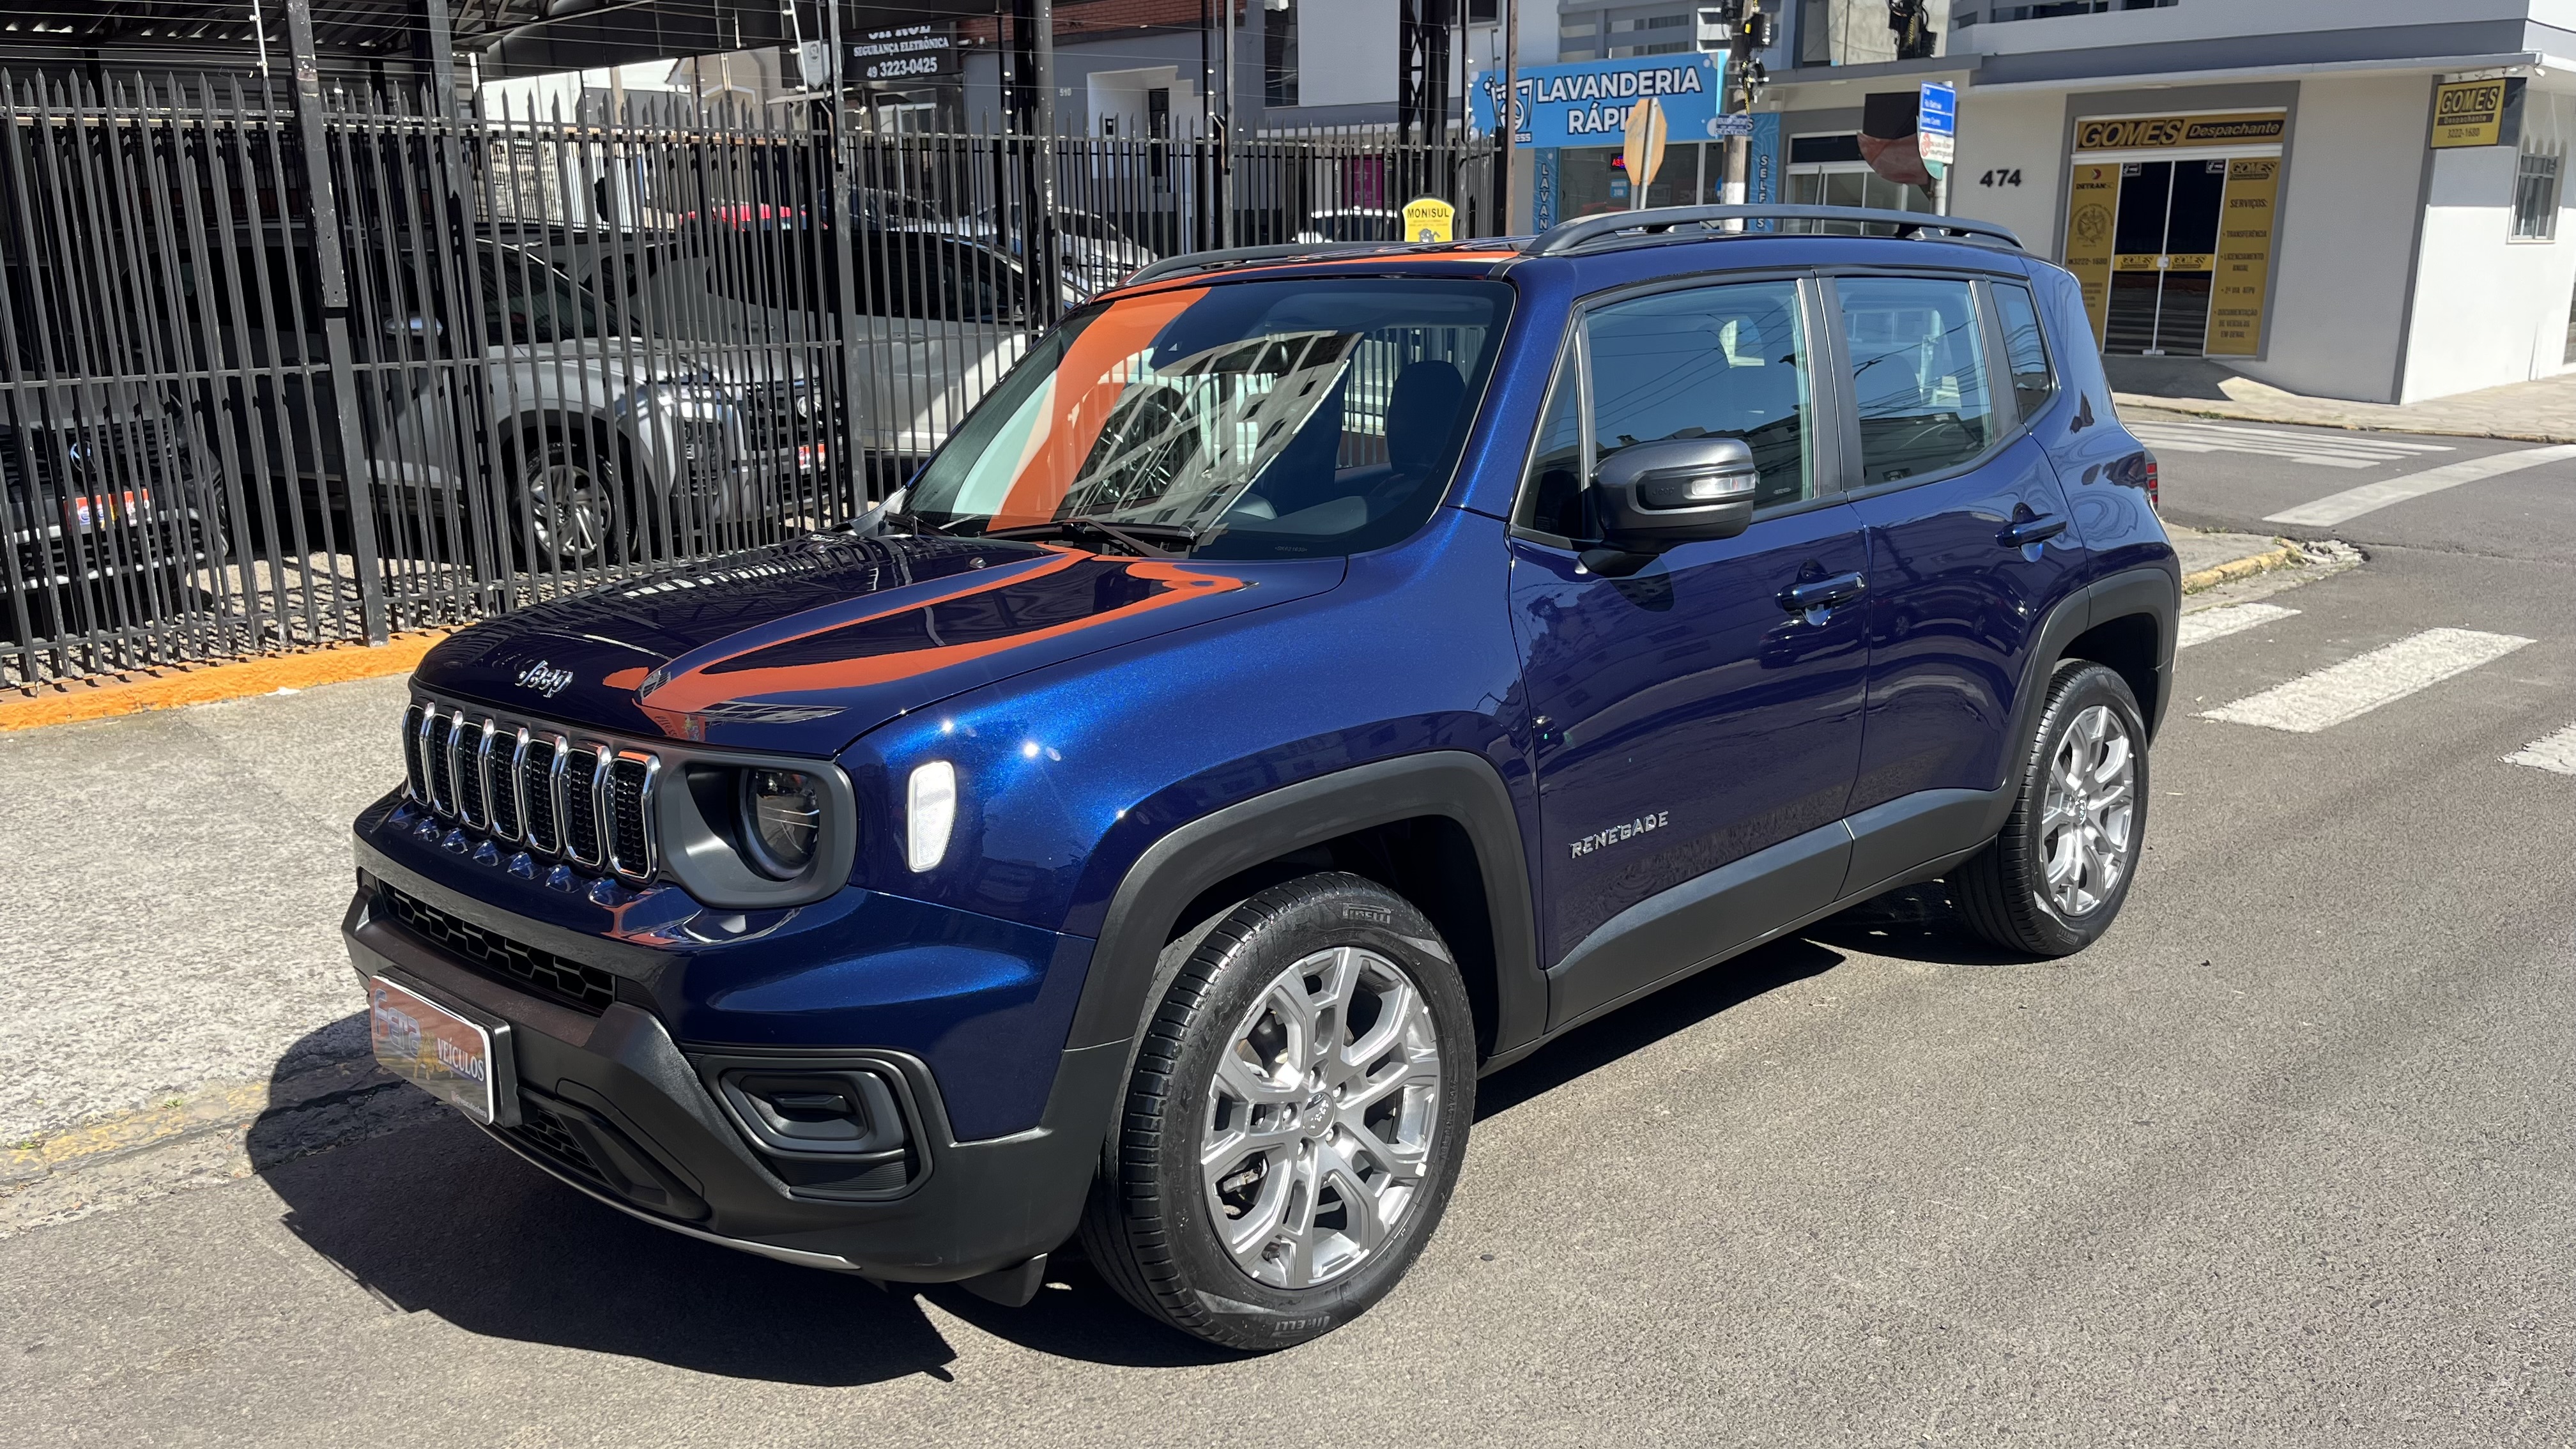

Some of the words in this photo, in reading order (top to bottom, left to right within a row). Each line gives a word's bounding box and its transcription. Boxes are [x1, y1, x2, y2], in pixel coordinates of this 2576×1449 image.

[854, 42, 900, 57] SEGURANÇA
[900, 36, 950, 53] ELETRÔNICA
[866, 66, 878, 78] 49
[880, 56, 938, 77] 3223-0425
[1536, 66, 1701, 102] LAVANDERIA
[2441, 87, 2500, 114] GOMES
[1568, 101, 1634, 134] RÁPI
[1515, 133, 1531, 142] ESS
[2080, 119, 2184, 148] GOMES
[2189, 121, 2281, 138] Despachante
[1758, 155, 1768, 204] SELF
[1980, 169, 2022, 188] 474
[1407, 208, 1449, 218] MONISUL
[1539, 163, 1549, 234] LAVAN
[515, 660, 574, 698] Jeep
[1568, 810, 1669, 859] RENEGADE
[1342, 903, 1392, 925] PIRELLI
[437, 1037, 485, 1082] VEÍCULOS
